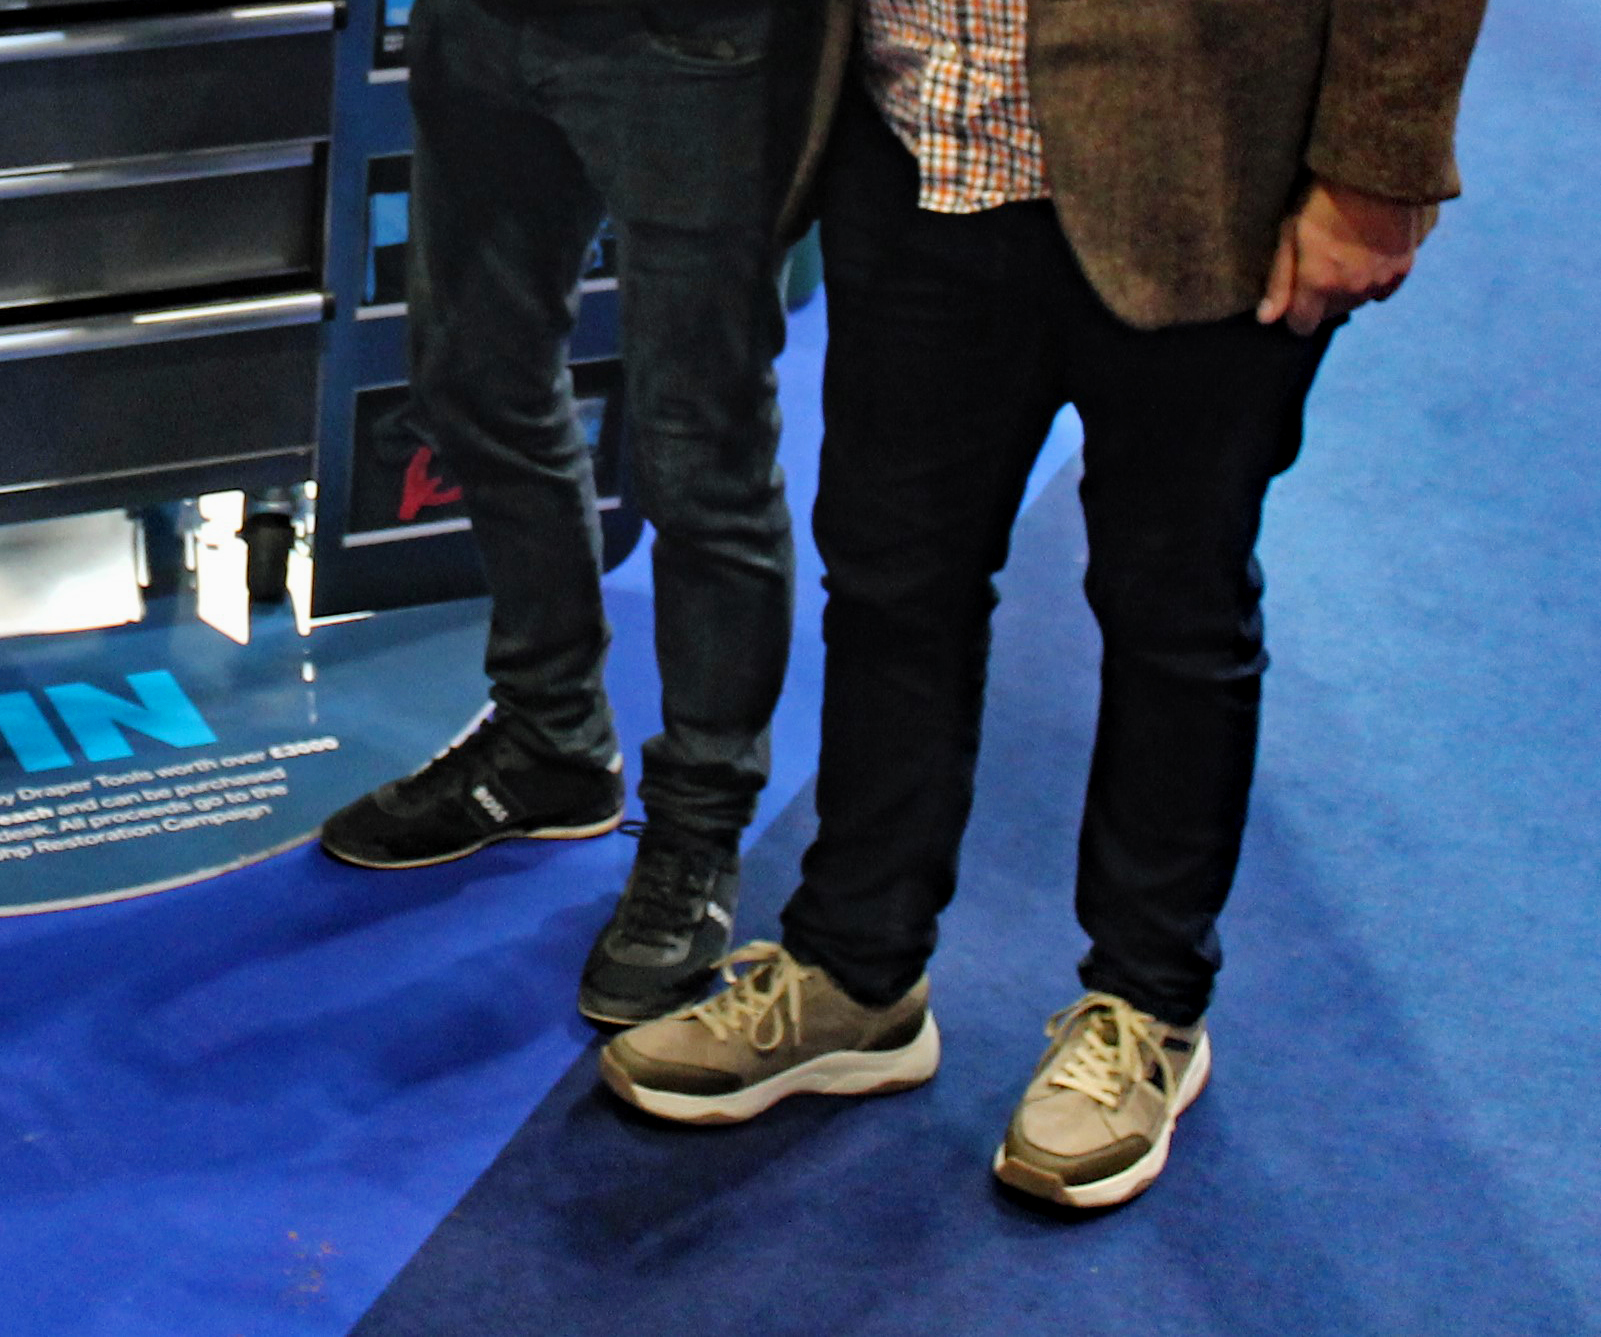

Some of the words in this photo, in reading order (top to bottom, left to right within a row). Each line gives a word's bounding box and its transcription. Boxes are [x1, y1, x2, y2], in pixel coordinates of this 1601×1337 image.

[15, 781, 92, 802] Draper
[95, 770, 155, 789] Tools
[154, 758, 219, 778] worth
[220, 750, 267, 768] over
[56, 797, 99, 816] and
[100, 791, 141, 808] can
[141, 786, 174, 802] be
[174, 766, 287, 798] purchased
[33, 823, 162, 854] Restoration
[161, 804, 273, 833] Campaign
[59, 815, 88, 832] All
[88, 800, 192, 830] proceeds
[193, 795, 225, 812] go
[224, 789, 251, 805] to
[250, 784, 289, 800] the
